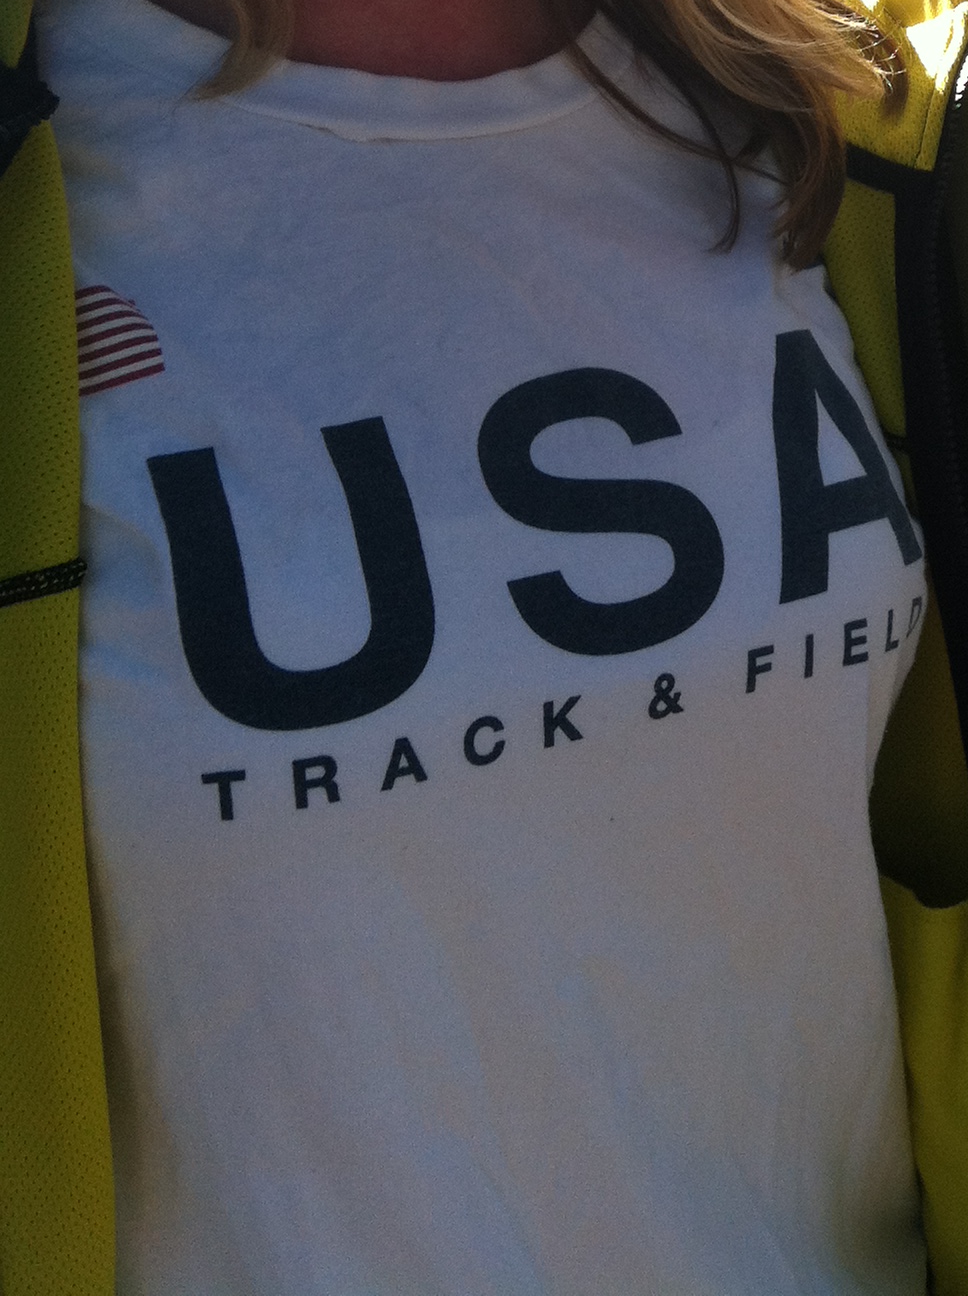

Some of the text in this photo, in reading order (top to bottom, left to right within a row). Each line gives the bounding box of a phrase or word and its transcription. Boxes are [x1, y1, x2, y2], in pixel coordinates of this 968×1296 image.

[146, 328, 923, 731] USA
[201, 596, 923, 821] TRACK & FIELD
